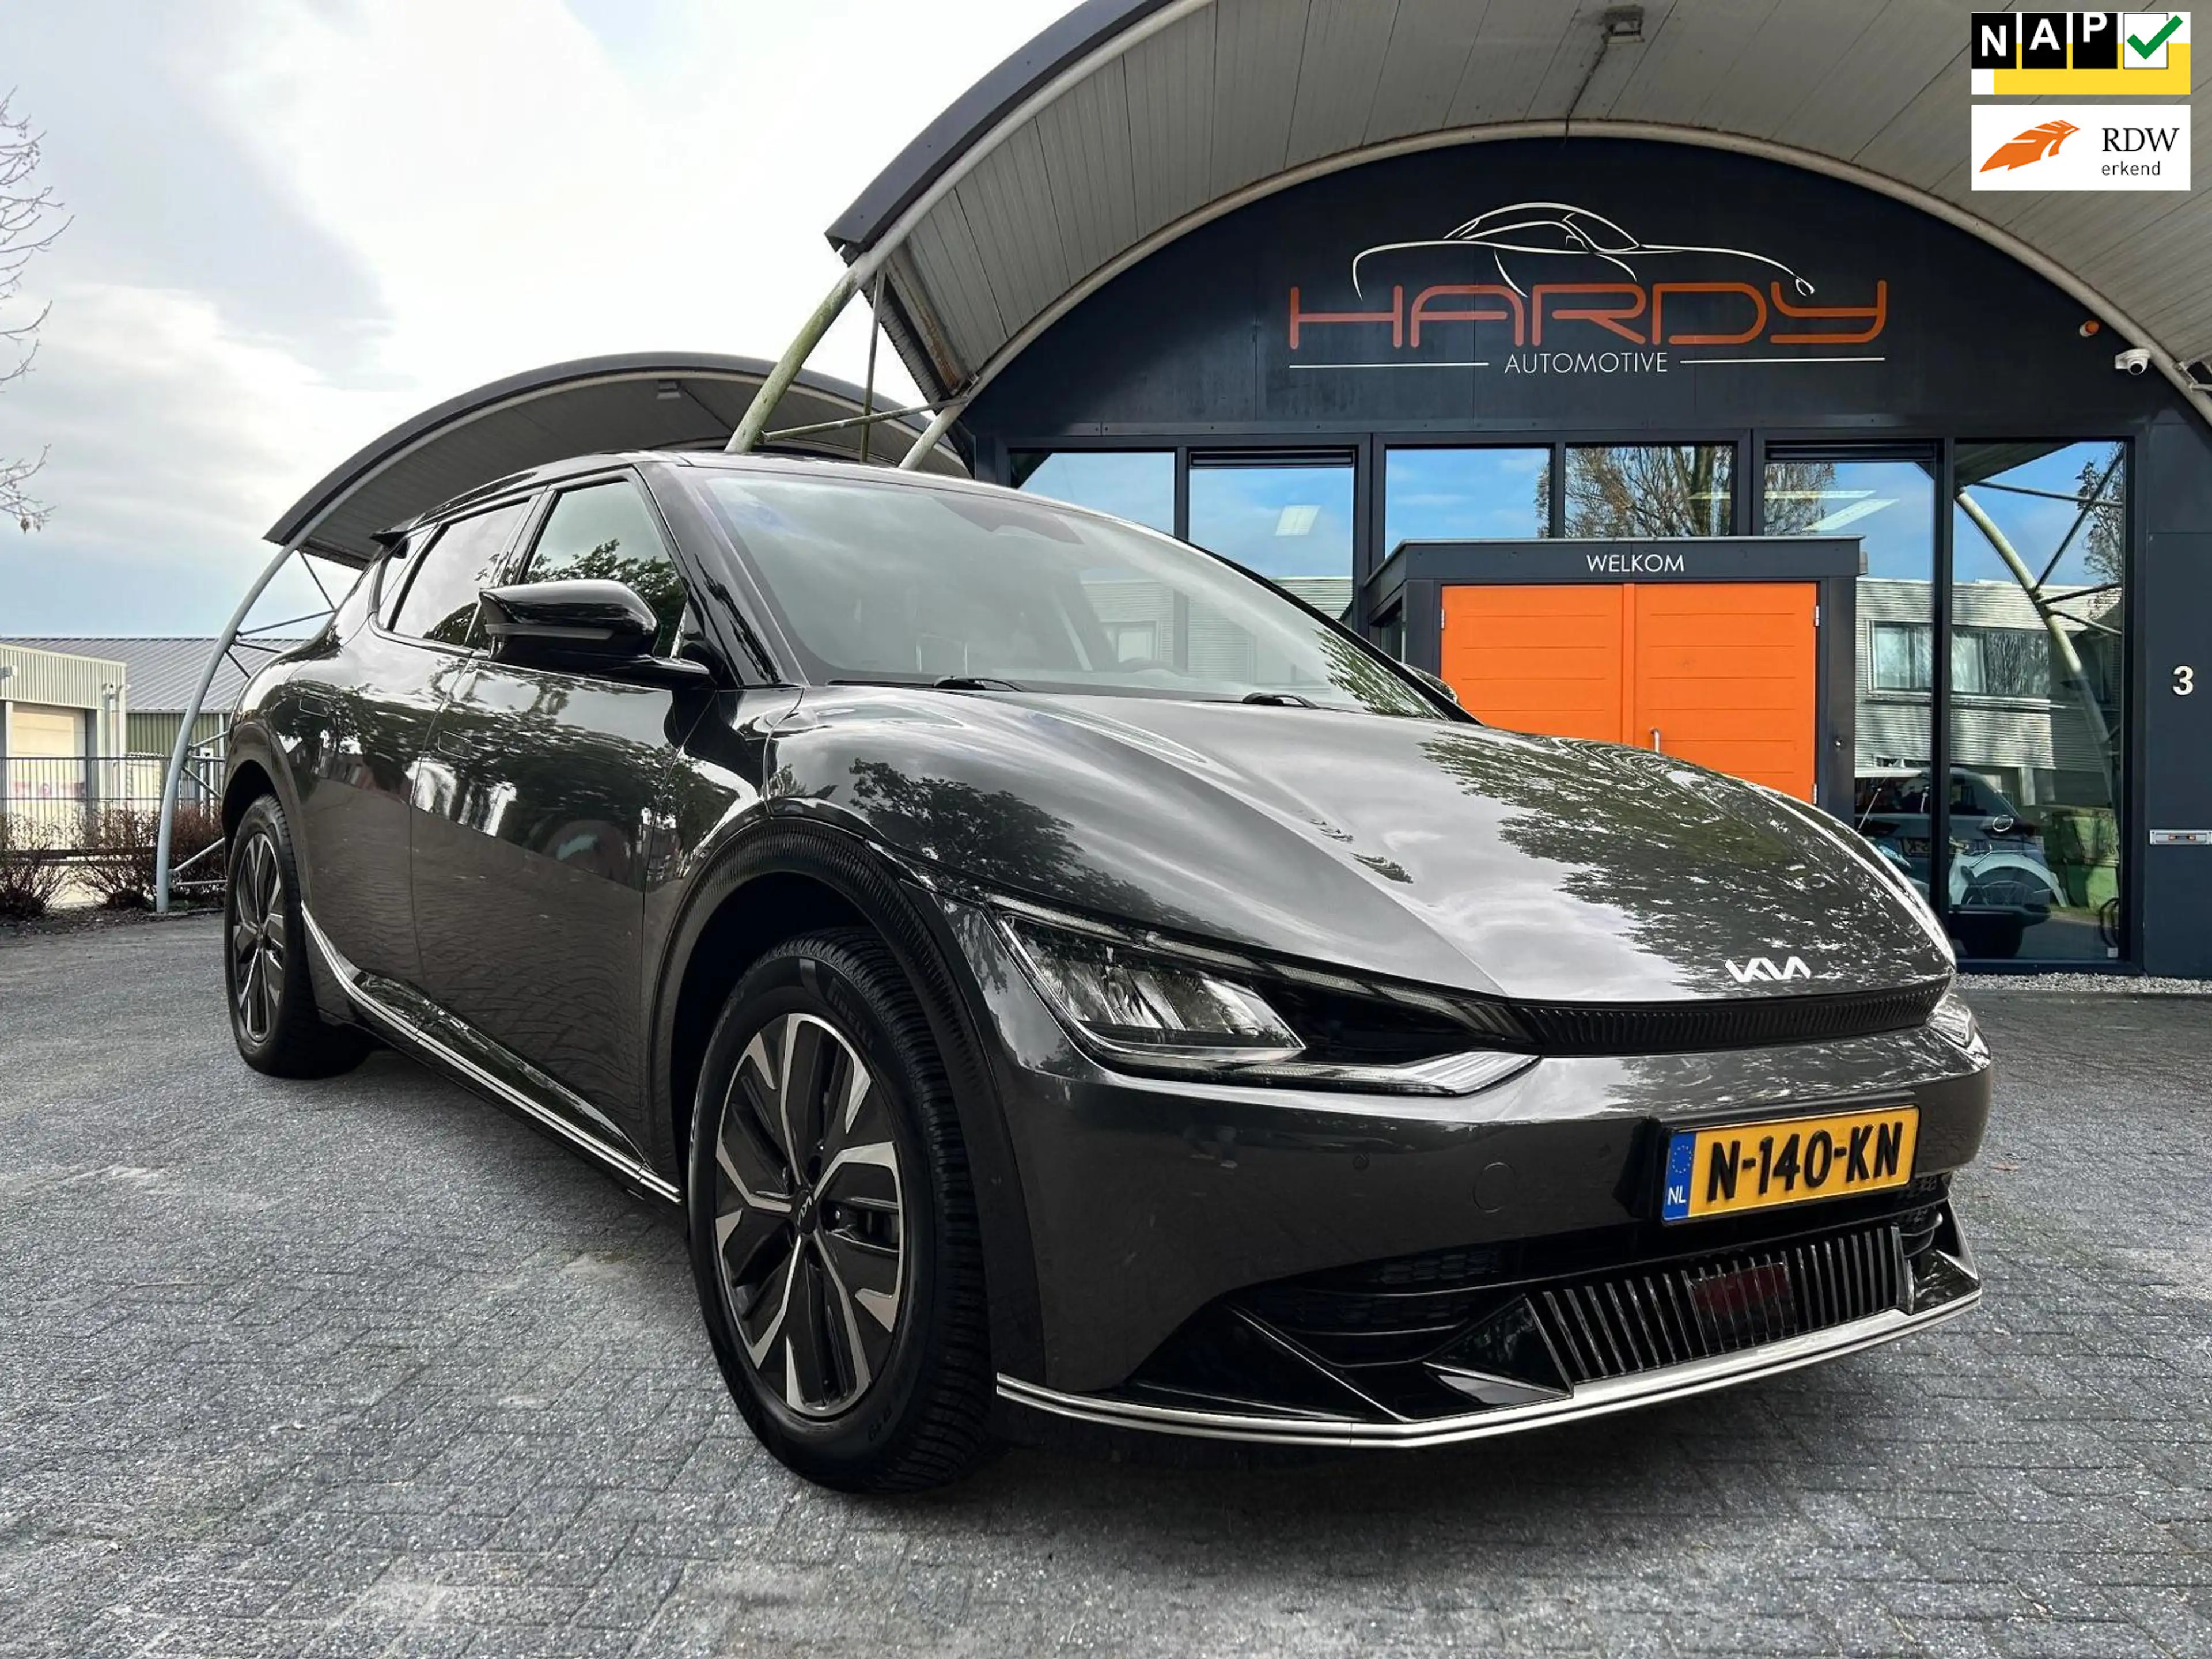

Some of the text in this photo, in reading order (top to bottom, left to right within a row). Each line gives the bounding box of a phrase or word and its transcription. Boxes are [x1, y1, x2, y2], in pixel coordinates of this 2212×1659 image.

[1290, 279, 1887, 349] HARDY
[1504, 351, 1668, 374] AUTOMOTIVE
[1586, 554, 1685, 573] WELKOM
[2172, 665, 2194, 696] 3
[1725, 956, 1812, 983] KIA
[1707, 1122, 1903, 1203] N-140-KN
[1667, 1185, 1687, 1205] NL
